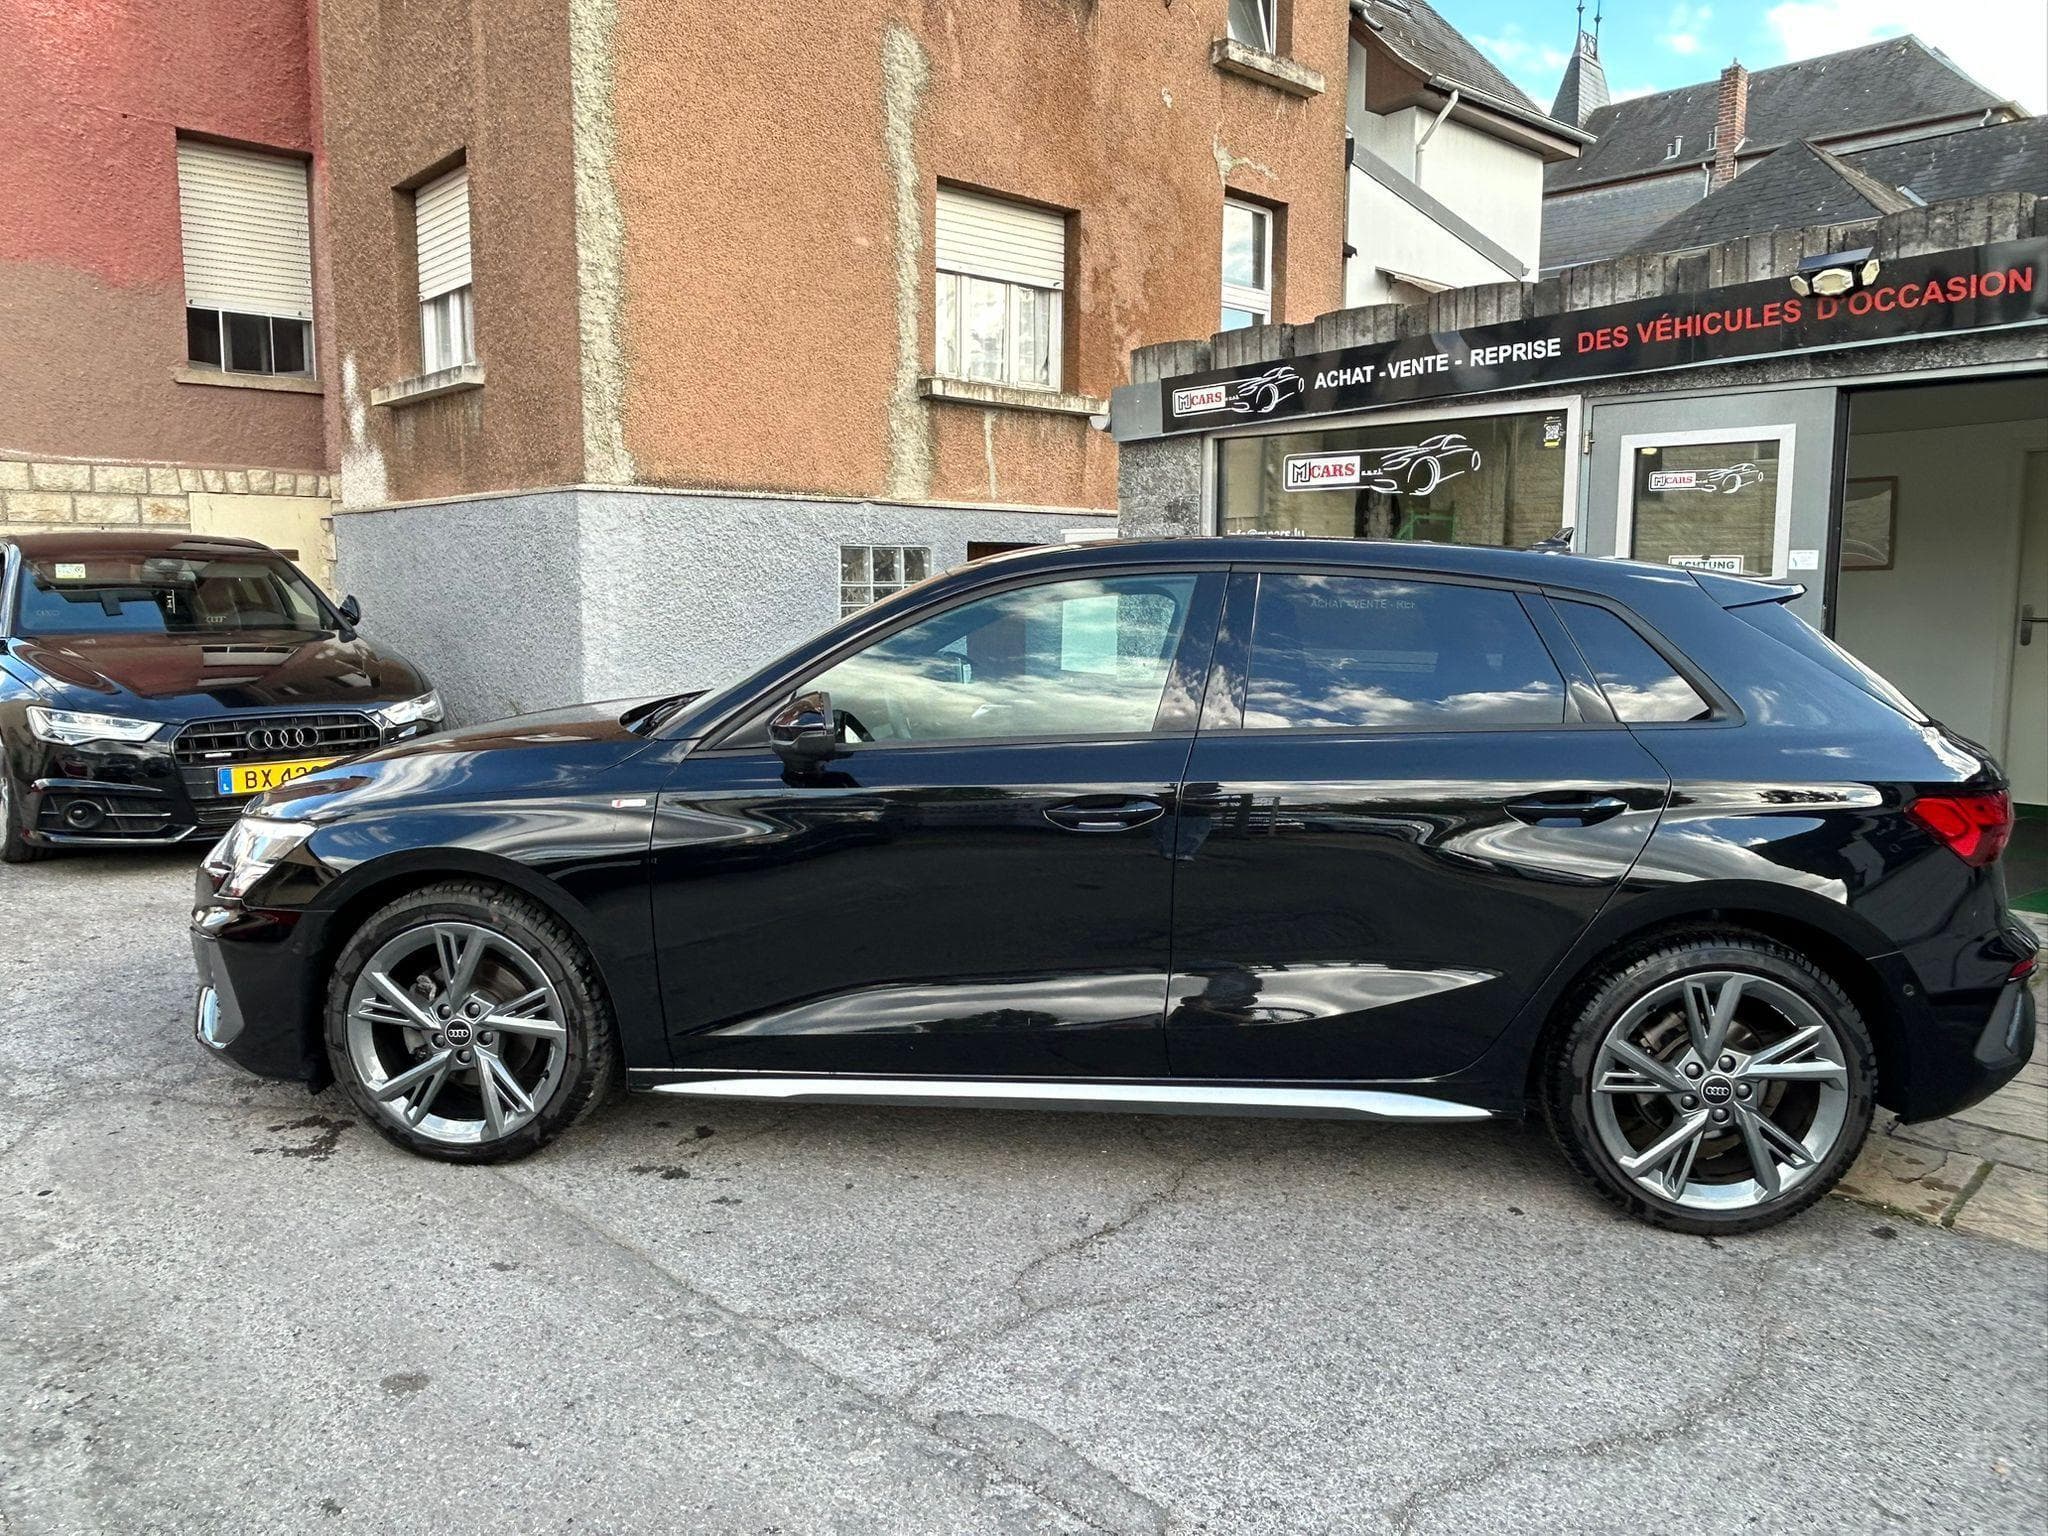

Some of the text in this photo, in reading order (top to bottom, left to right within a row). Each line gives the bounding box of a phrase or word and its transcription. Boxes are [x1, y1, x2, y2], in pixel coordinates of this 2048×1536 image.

[1314, 365, 1375, 389] ACHAT
[1470, 338, 1561, 367] REPRISE
[1577, 325, 1629, 354] DES
[1636, 299, 1802, 343] VÉHICULES
[1816, 266, 2033, 321] D'OCCASION
[245, 769, 273, 789] BX
